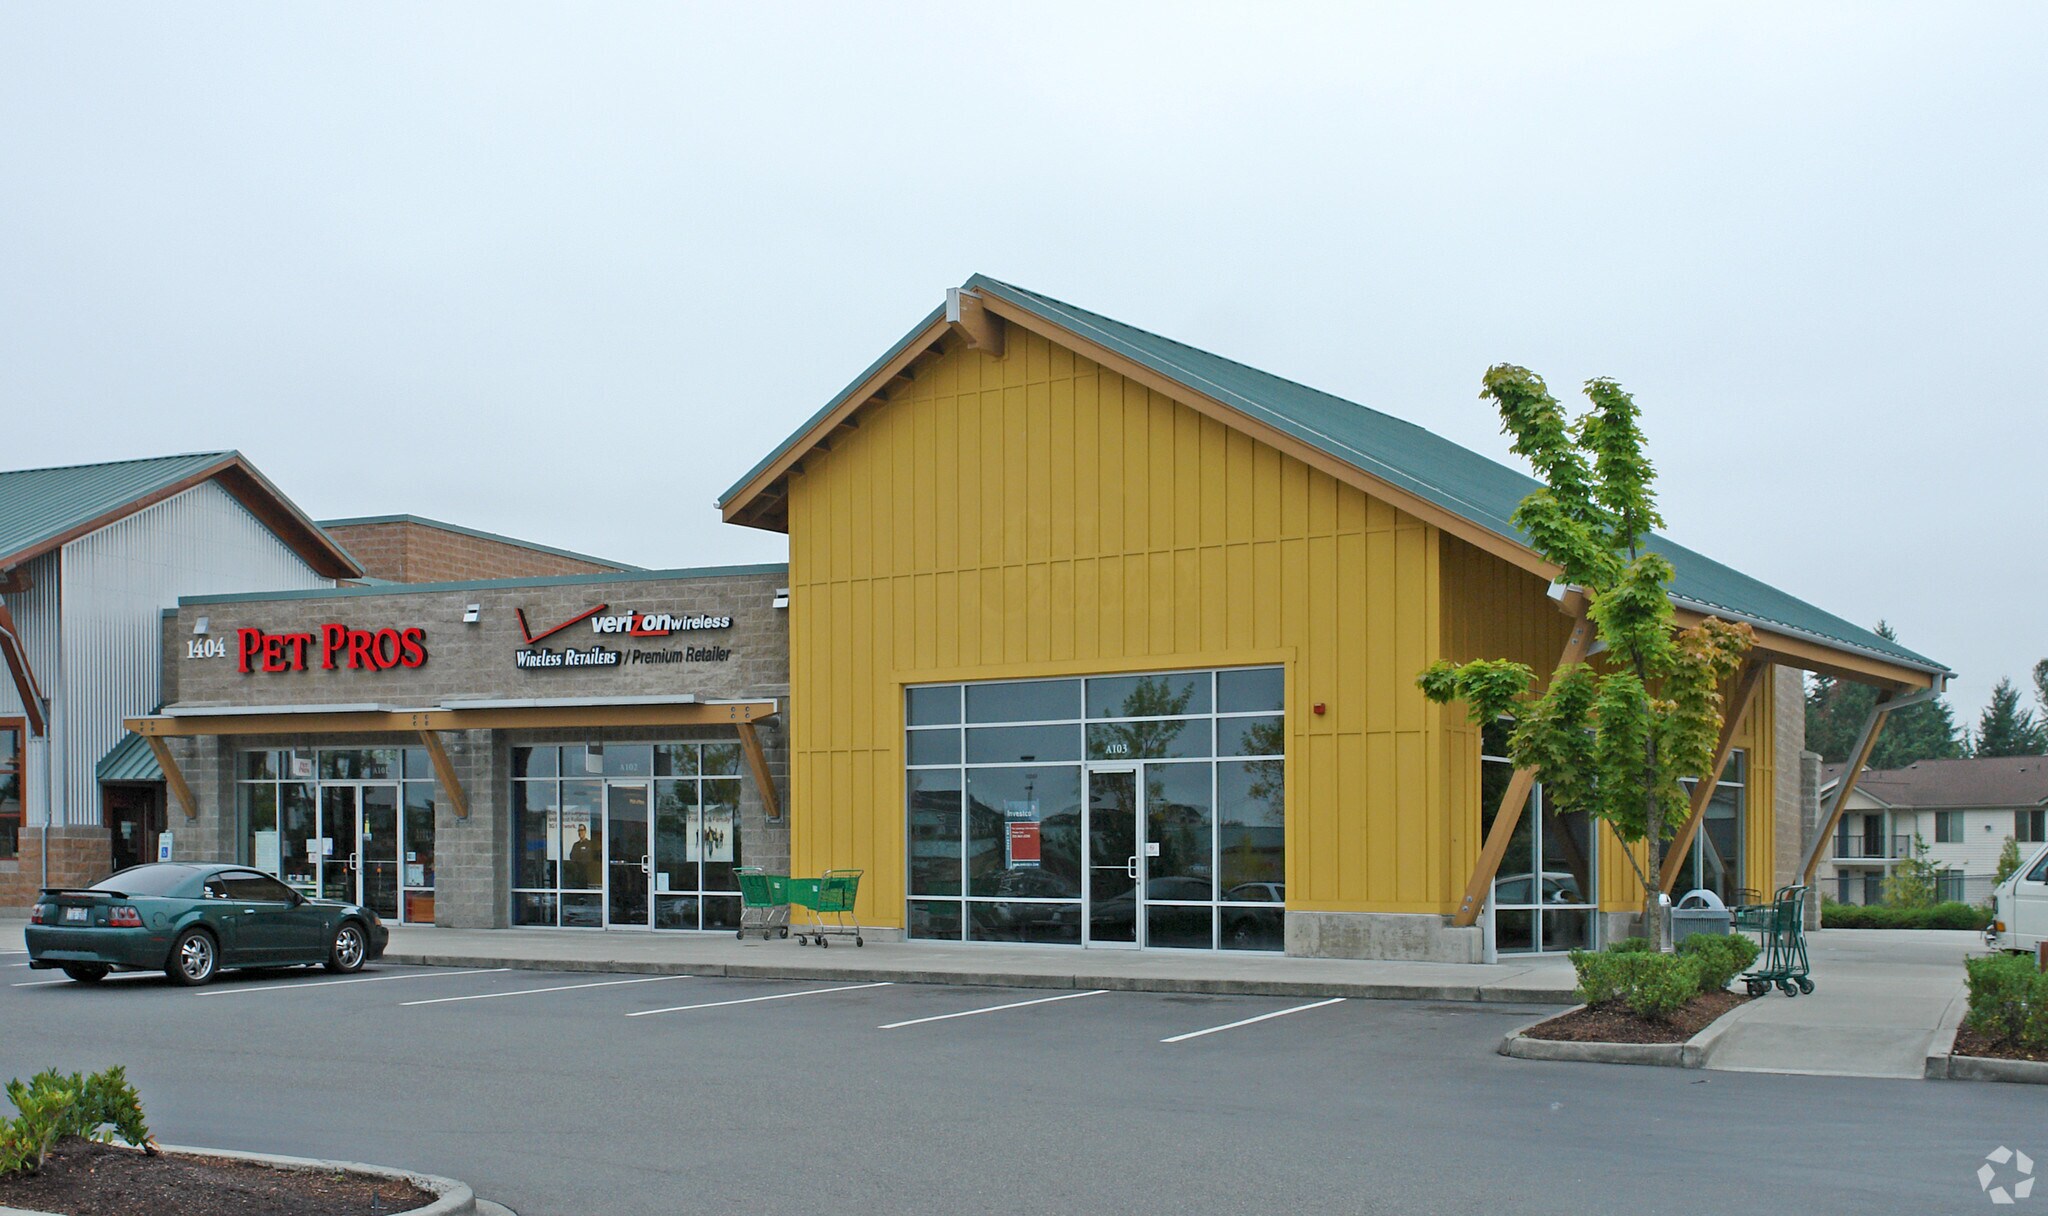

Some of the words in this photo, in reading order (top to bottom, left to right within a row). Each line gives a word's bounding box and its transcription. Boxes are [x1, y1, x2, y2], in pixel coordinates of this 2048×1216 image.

[186, 636, 226, 659] 1404
[237, 627, 314, 673] PET
[321, 623, 427, 673] PROS
[632, 649, 682, 665] Premium
[686, 646, 731, 662] Retailer
[1105, 744, 1128, 754] A103
[620, 763, 638, 771] A102
